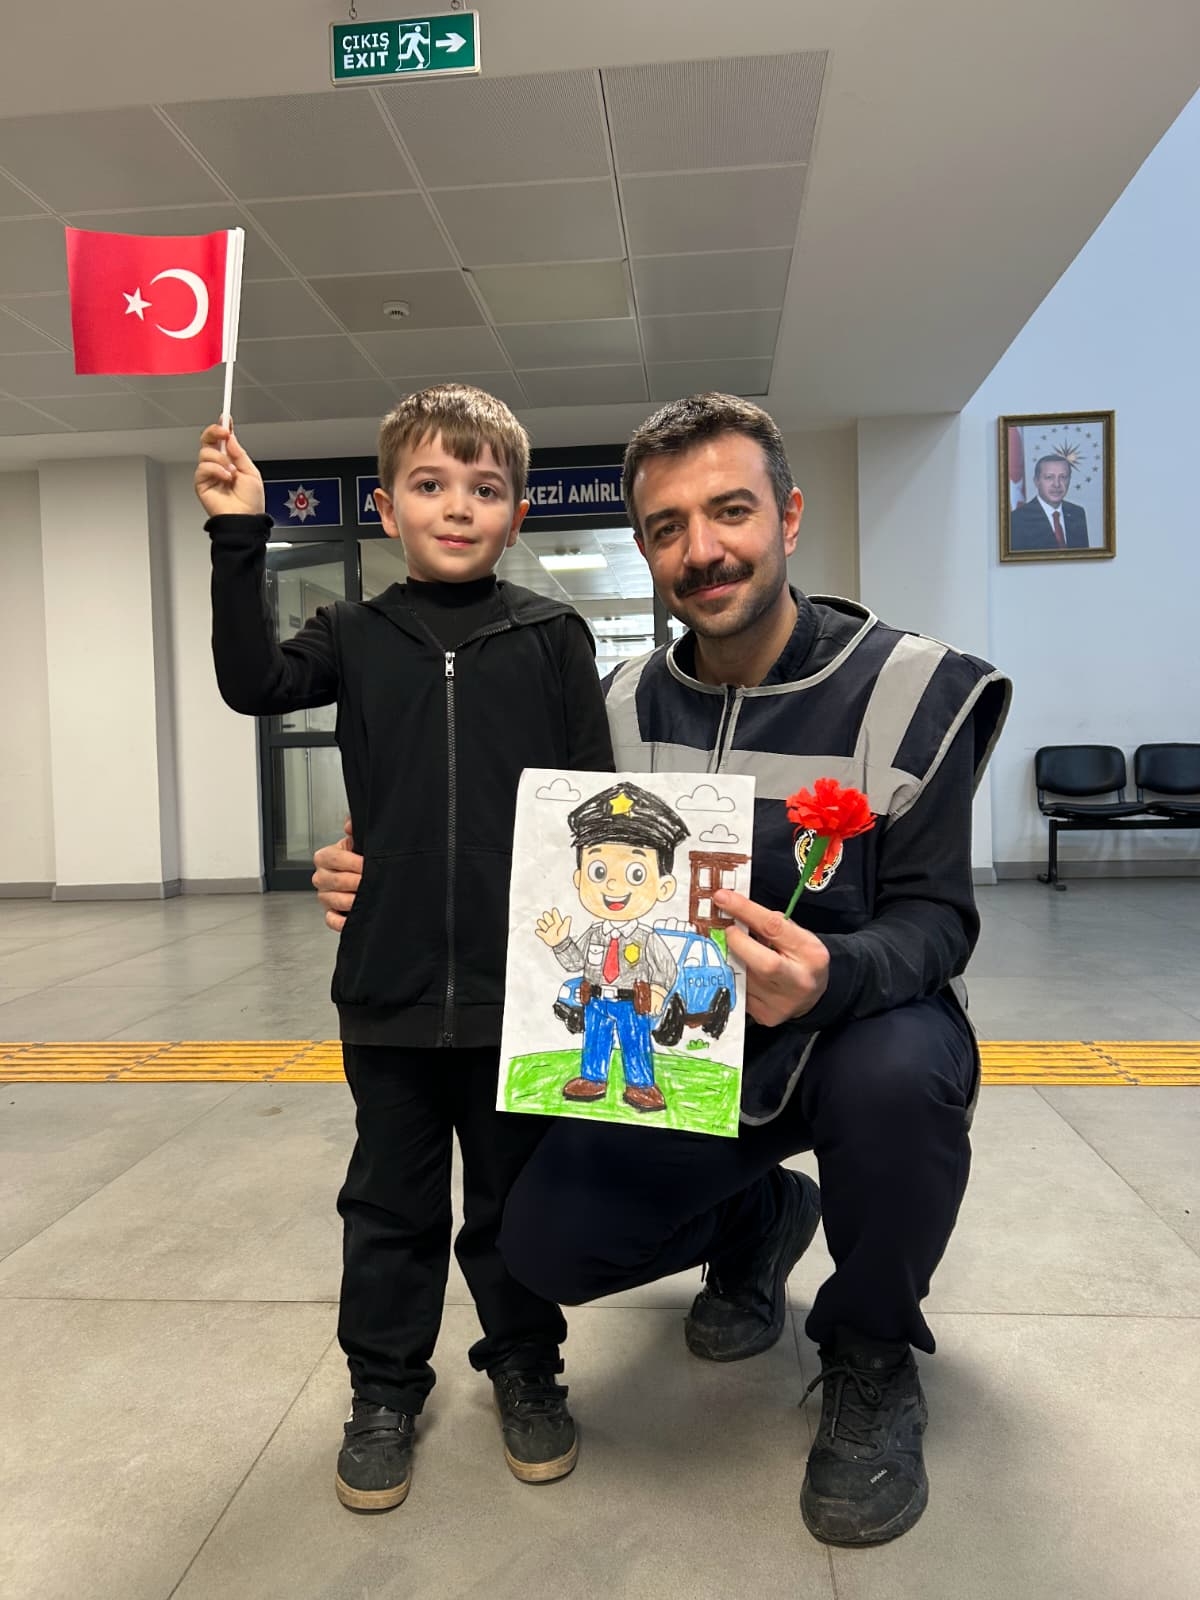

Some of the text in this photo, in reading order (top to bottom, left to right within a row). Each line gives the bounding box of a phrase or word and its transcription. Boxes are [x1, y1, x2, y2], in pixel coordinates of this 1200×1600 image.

[342, 32, 390, 53] ÇIKIŞ
[343, 51, 389, 70] EXIT
[364, 478, 625, 512] A KEZİ AMİRLİ
[688, 975, 725, 988] POLICE
